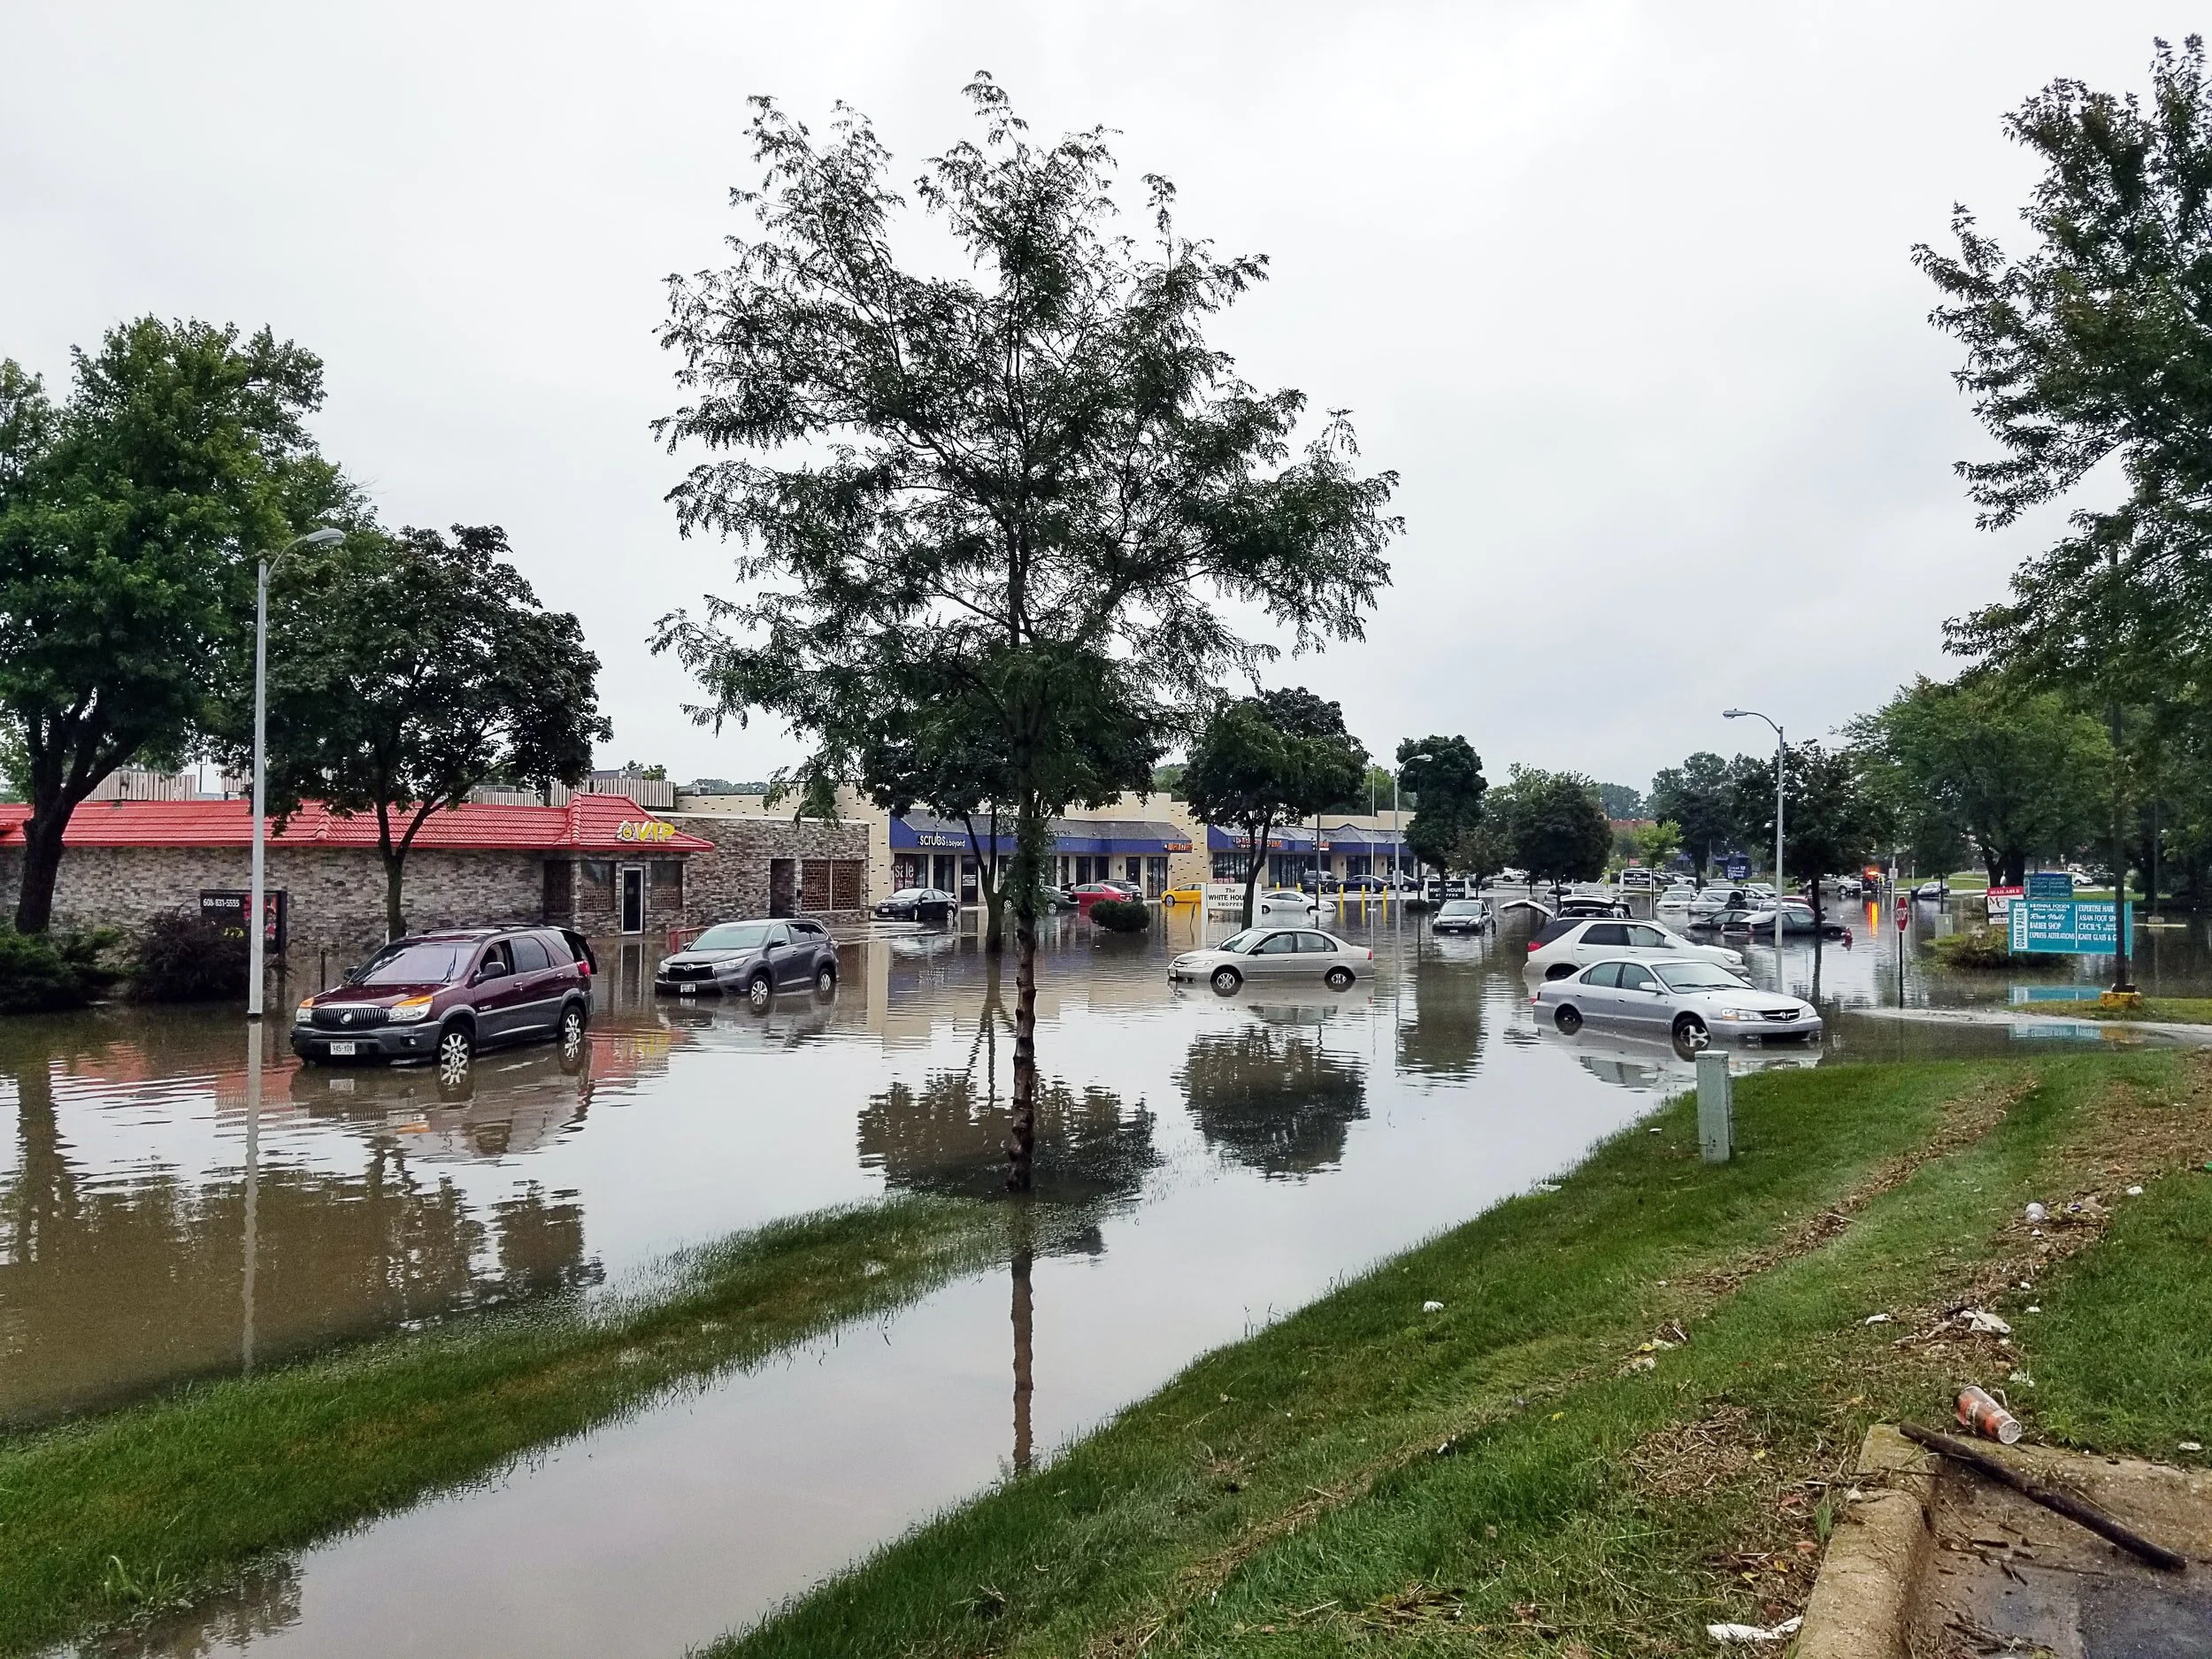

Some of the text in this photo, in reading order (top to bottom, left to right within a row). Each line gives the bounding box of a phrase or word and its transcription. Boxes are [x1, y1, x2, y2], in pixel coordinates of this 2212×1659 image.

[634, 821, 675, 841] VIP
[920, 833, 946, 846] scrubs
[1897, 907, 1908, 921] STOP
